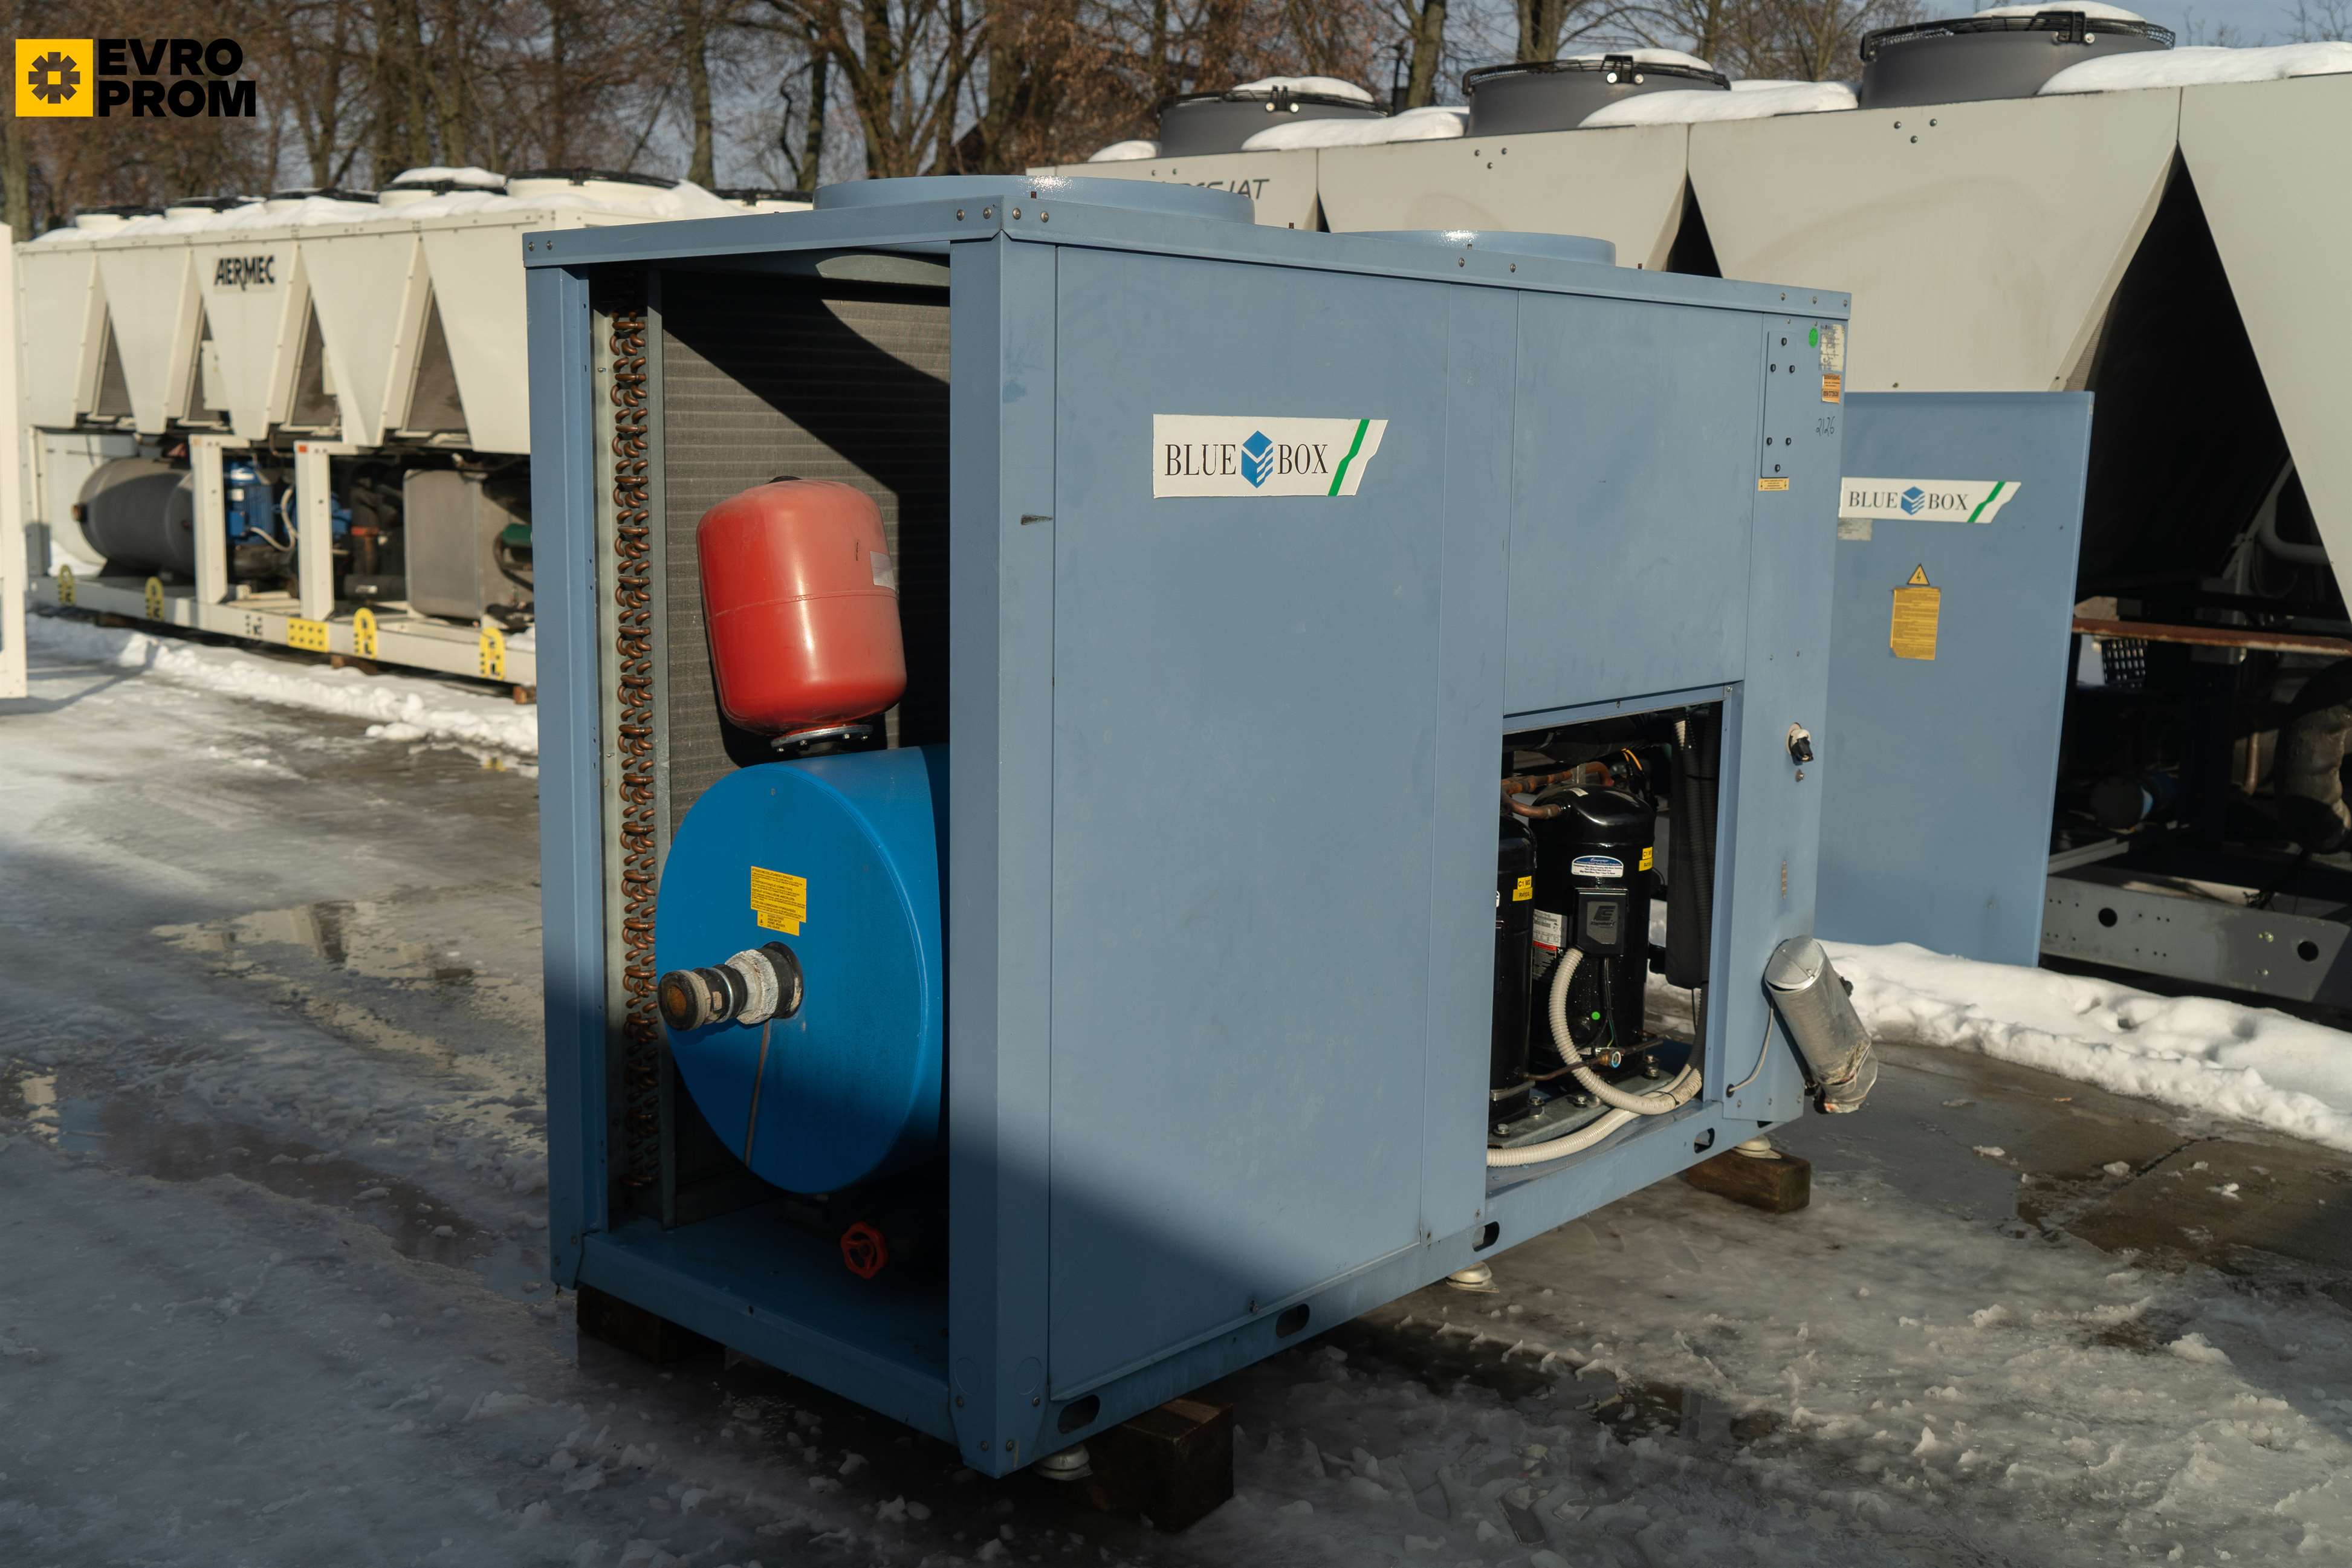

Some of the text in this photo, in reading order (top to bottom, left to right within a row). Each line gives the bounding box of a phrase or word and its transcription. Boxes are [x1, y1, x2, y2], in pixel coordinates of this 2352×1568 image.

[214, 254, 274, 291] AERMEC
[1164, 444, 1329, 476] BLUE BOX
[1848, 490, 1971, 511] BLUE BOX
